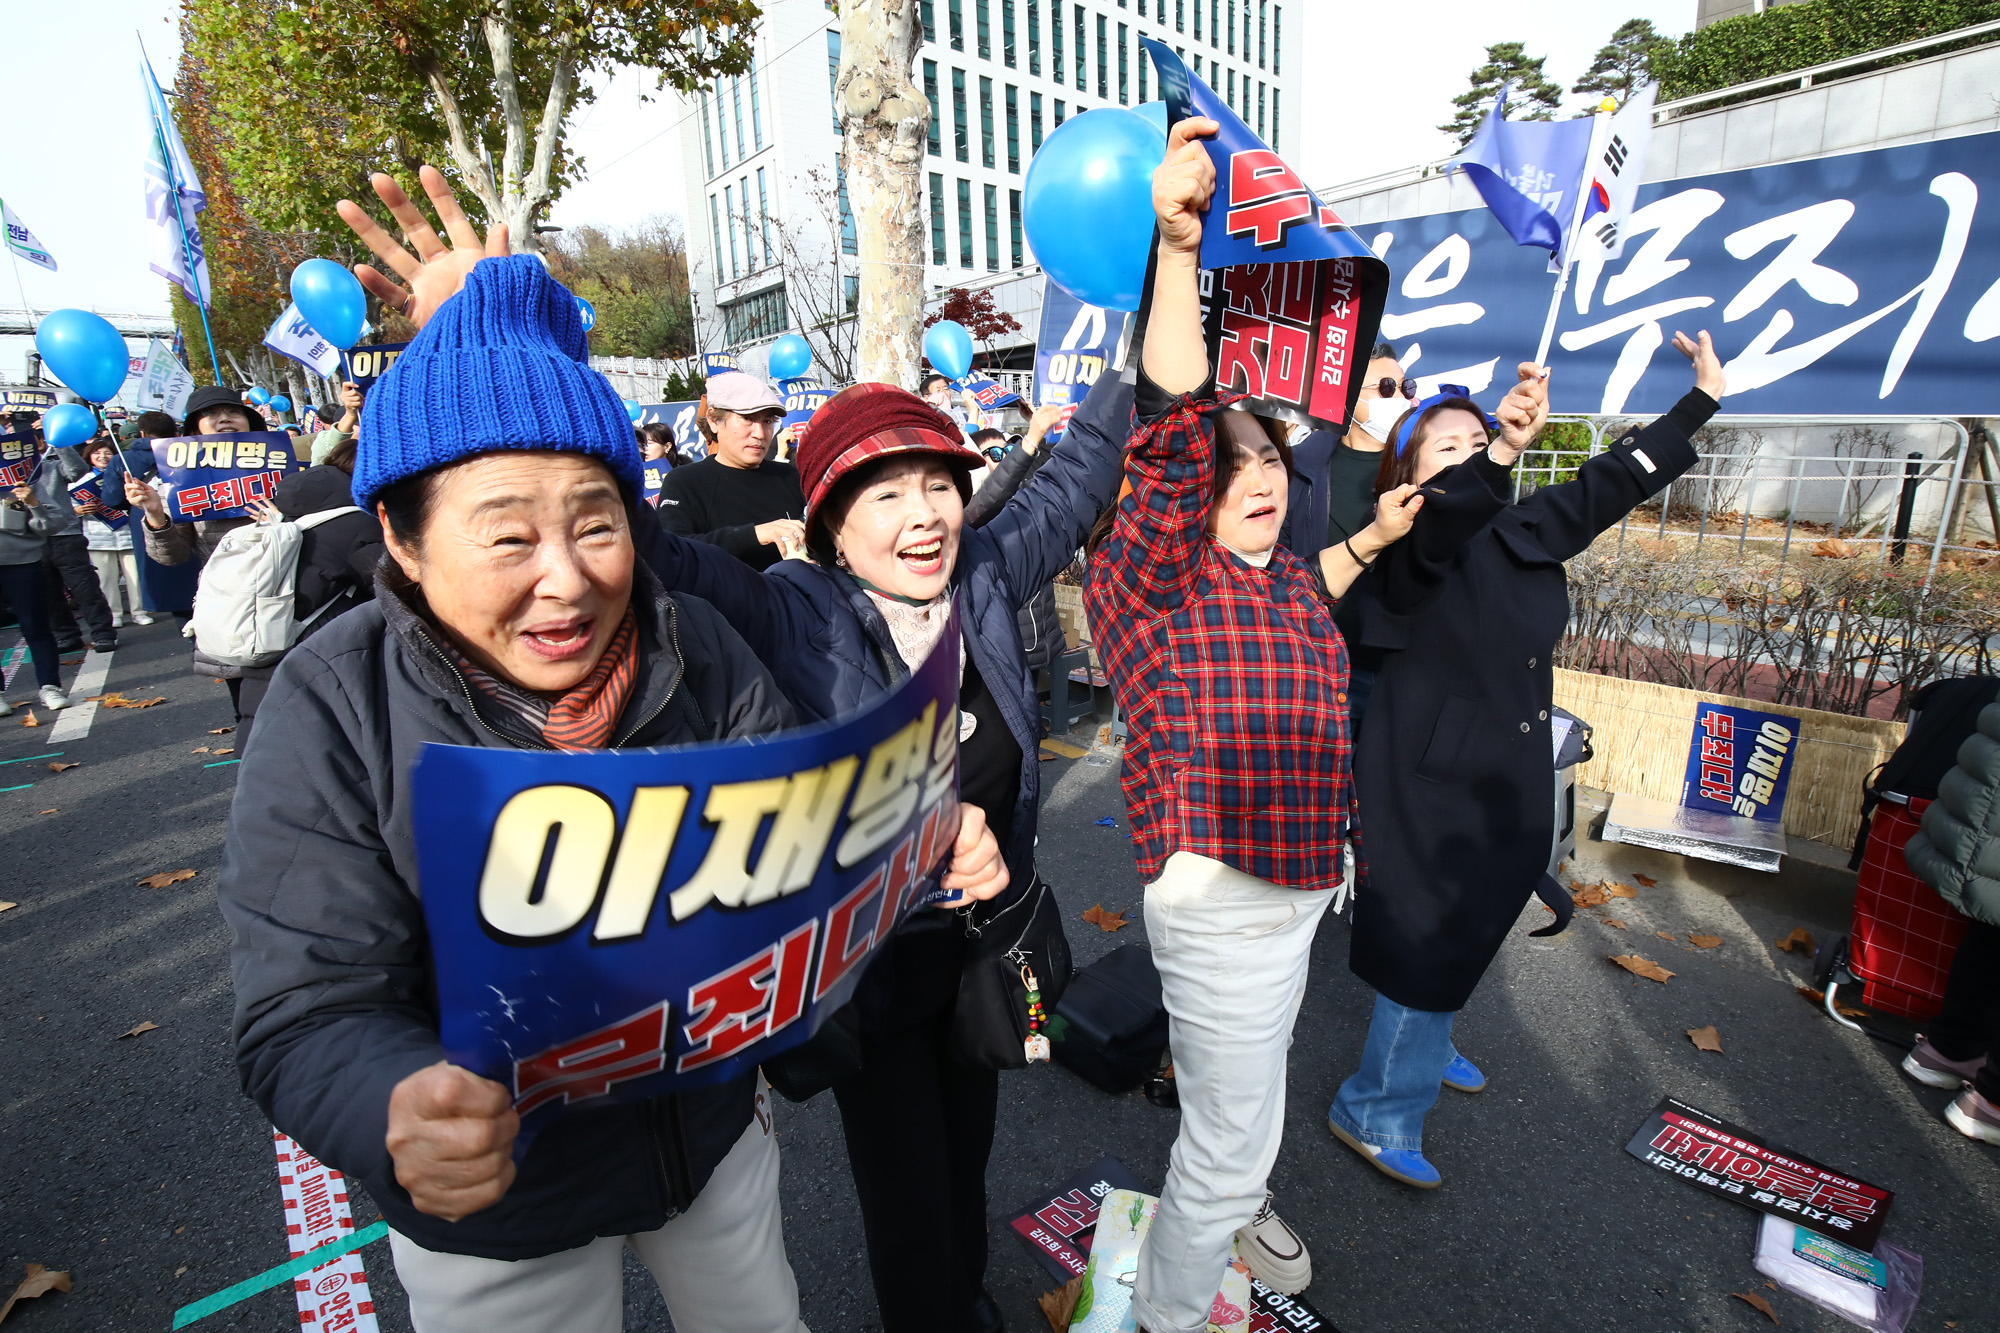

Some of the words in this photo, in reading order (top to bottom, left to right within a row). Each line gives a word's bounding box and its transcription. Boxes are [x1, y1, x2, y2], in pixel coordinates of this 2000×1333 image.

[1331, 258, 1354, 320] 수사검
[1048, 354, 1108, 386] 이재
[1321, 325, 1348, 386] 김건희
[785, 394, 828, 411] 이재
[166, 441, 287, 469] 이재명은
[1700, 710, 1734, 803] 무죄다!
[1732, 720, 1792, 818] 이재명은
[1679, 1119, 1731, 1144] 탄핵하라!
[1645, 1151, 1745, 1194] 탄핵하라!
[1649, 1124, 1876, 1222] 검찰해체
[1762, 1152, 1816, 1174] 수사검사
[1818, 1172, 1860, 1190] 김건희
[300, 1174, 334, 1236] DANGER!
[1750, 1190, 1853, 1230] 정치검찰
[1029, 1227, 1062, 1253] 김건희
[319, 1292, 357, 1333] 안전
[1211, 1304, 1241, 1322] OVE
